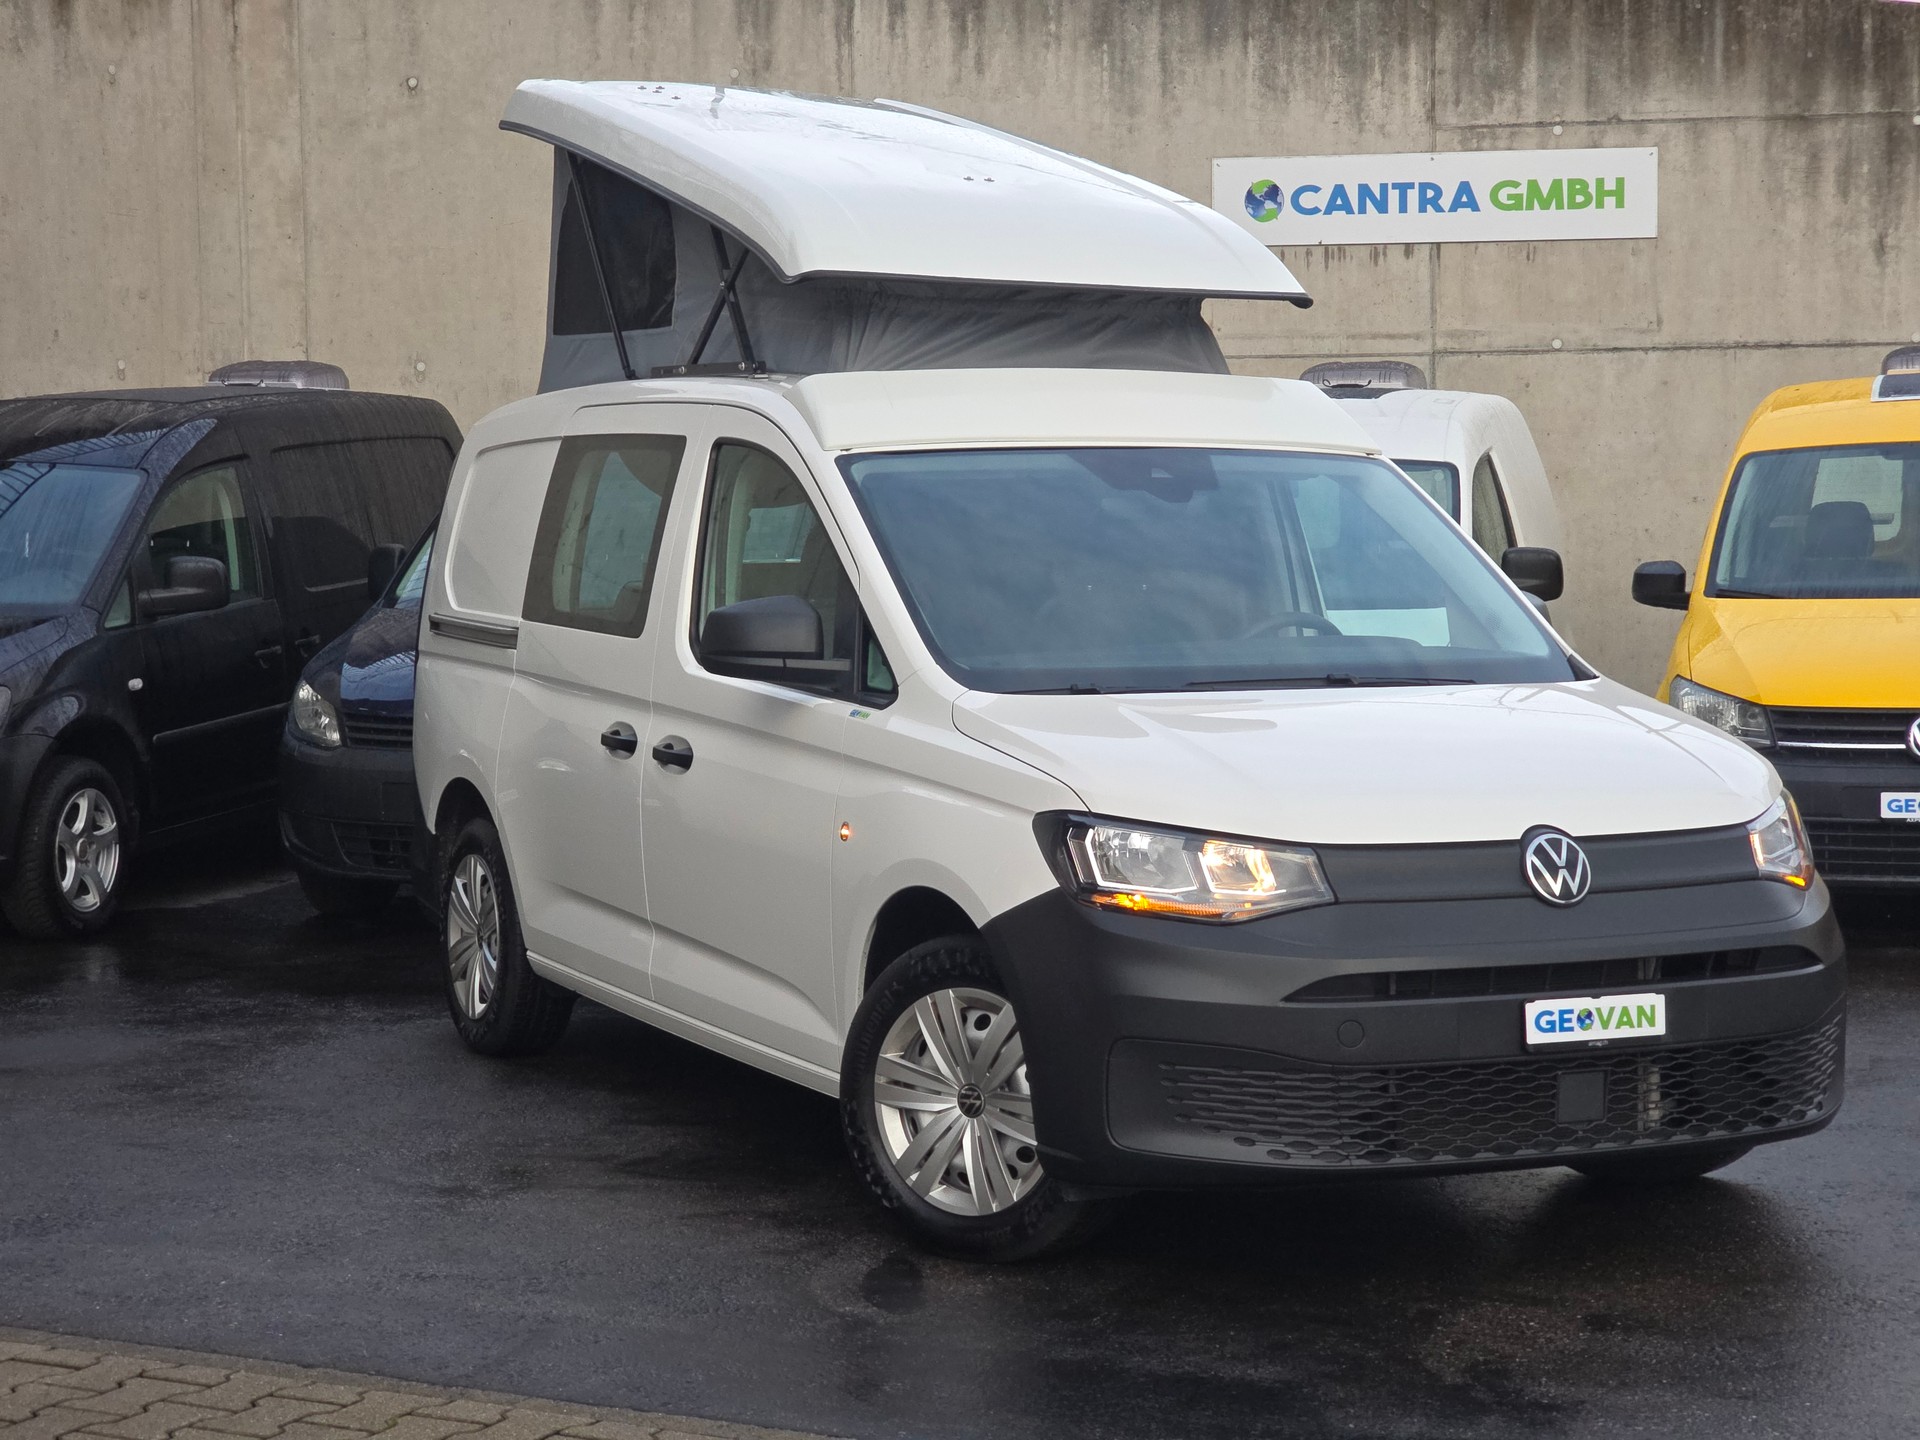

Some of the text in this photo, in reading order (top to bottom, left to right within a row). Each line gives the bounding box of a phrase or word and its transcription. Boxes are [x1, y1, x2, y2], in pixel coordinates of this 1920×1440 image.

[1290, 177, 1625, 216] CANTRA GMBH
[1887, 798, 1920, 813] GE
[1534, 1004, 1656, 1034] GEOVAN
